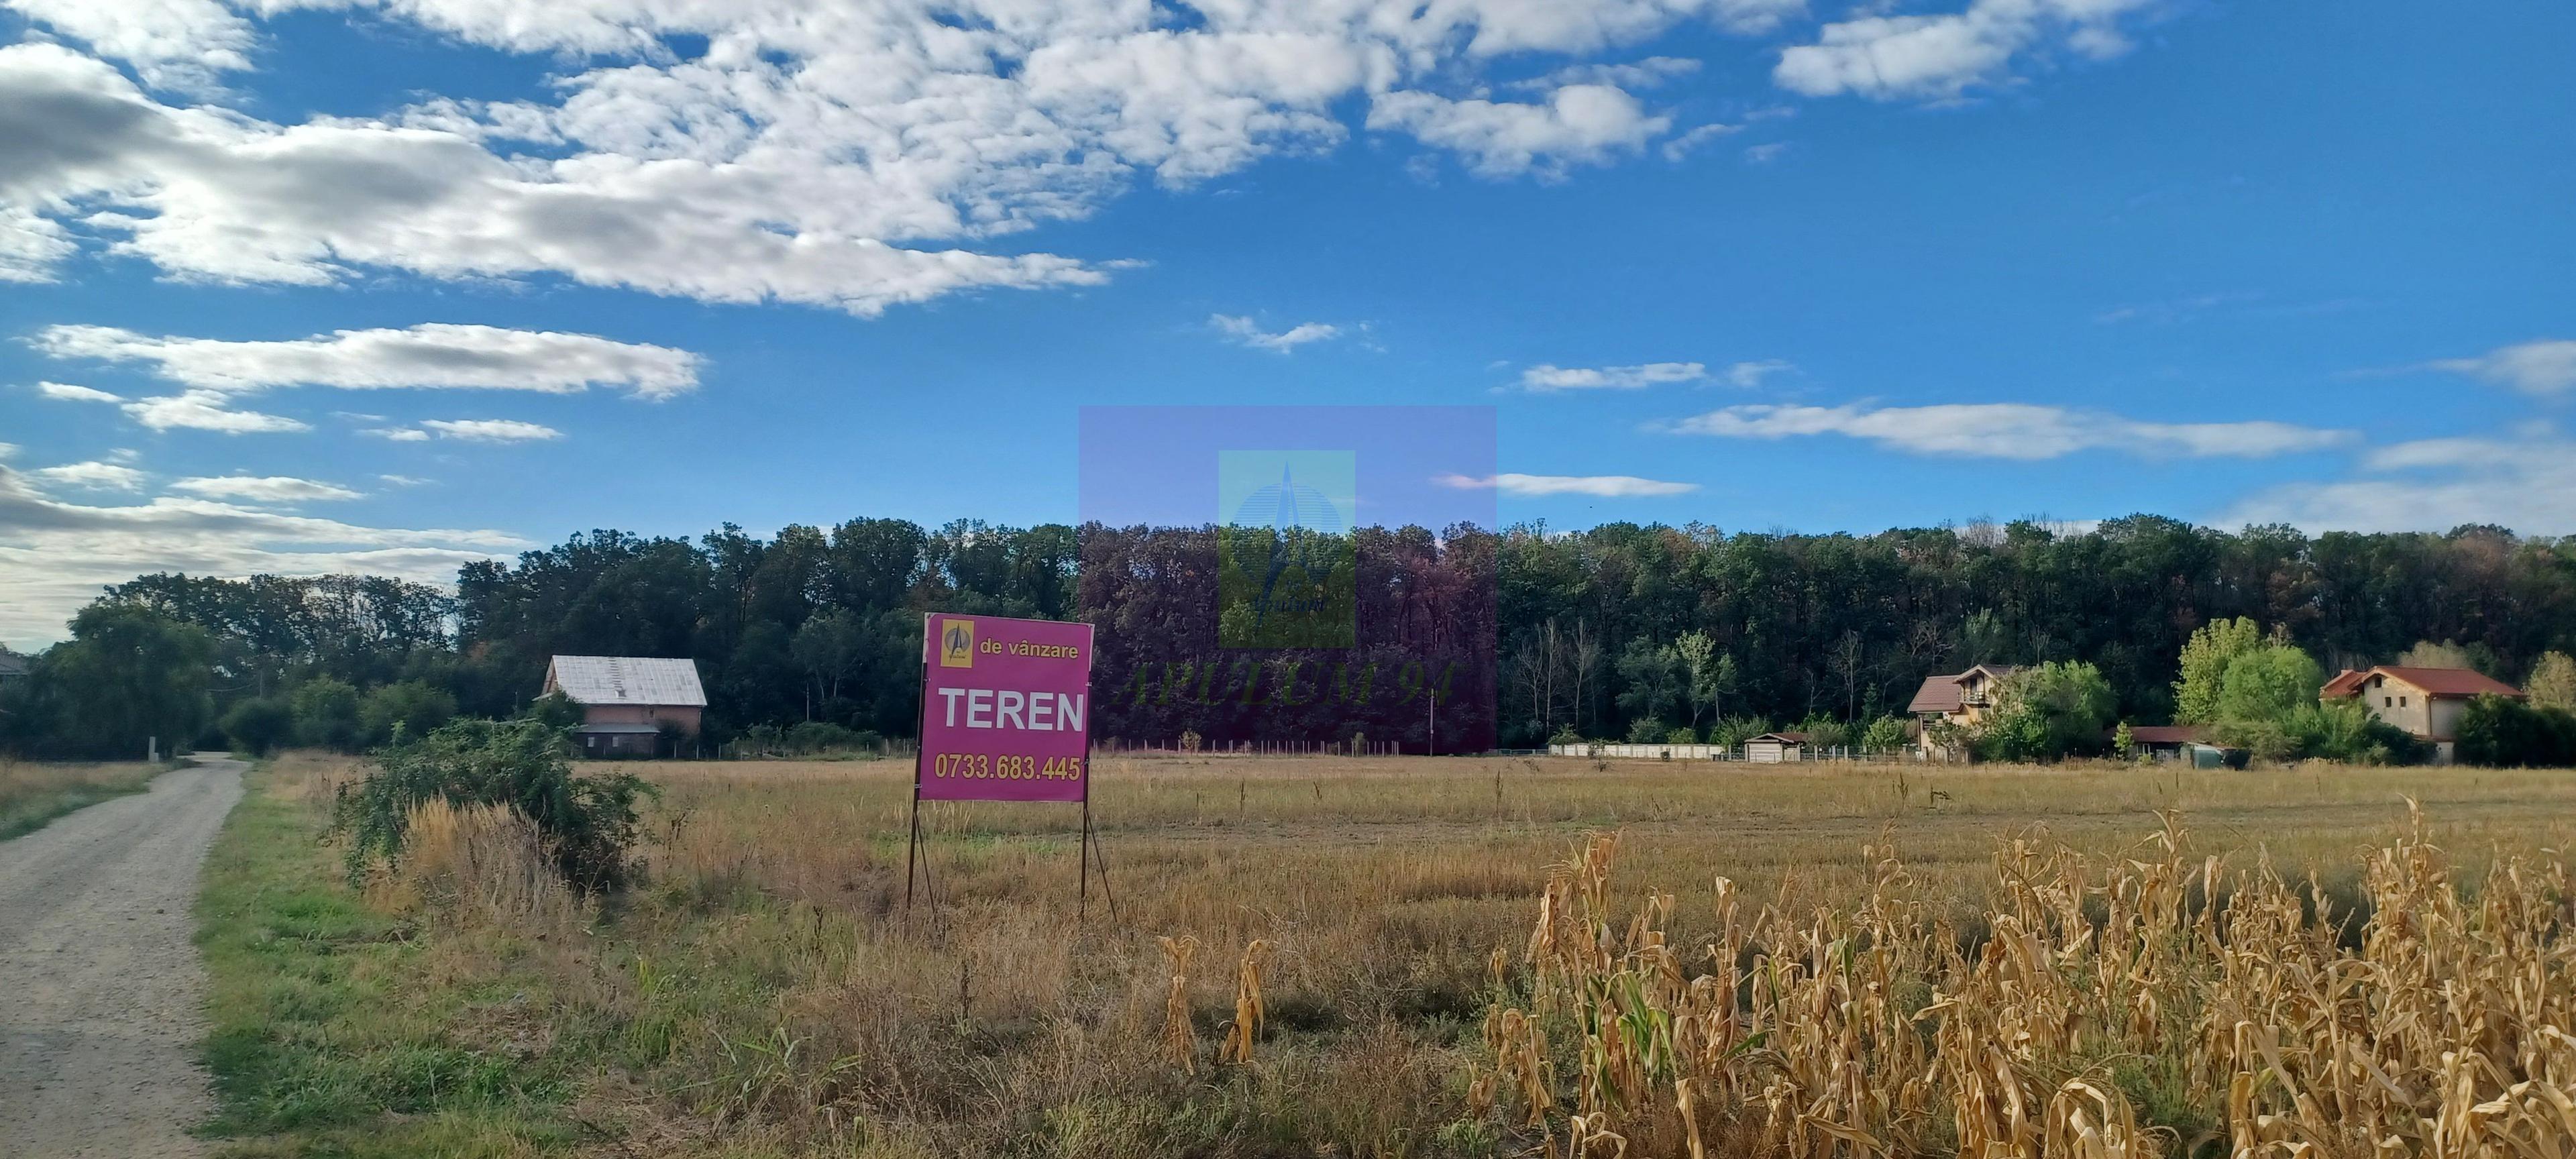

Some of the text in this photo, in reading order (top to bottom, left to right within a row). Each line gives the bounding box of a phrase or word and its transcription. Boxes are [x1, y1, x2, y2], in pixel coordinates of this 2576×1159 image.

[980, 638, 1002, 655] de
[1008, 640, 1079, 659] vânzare
[938, 687, 1083, 732] TEREN
[935, 753, 1081, 780] 0733.683.445
